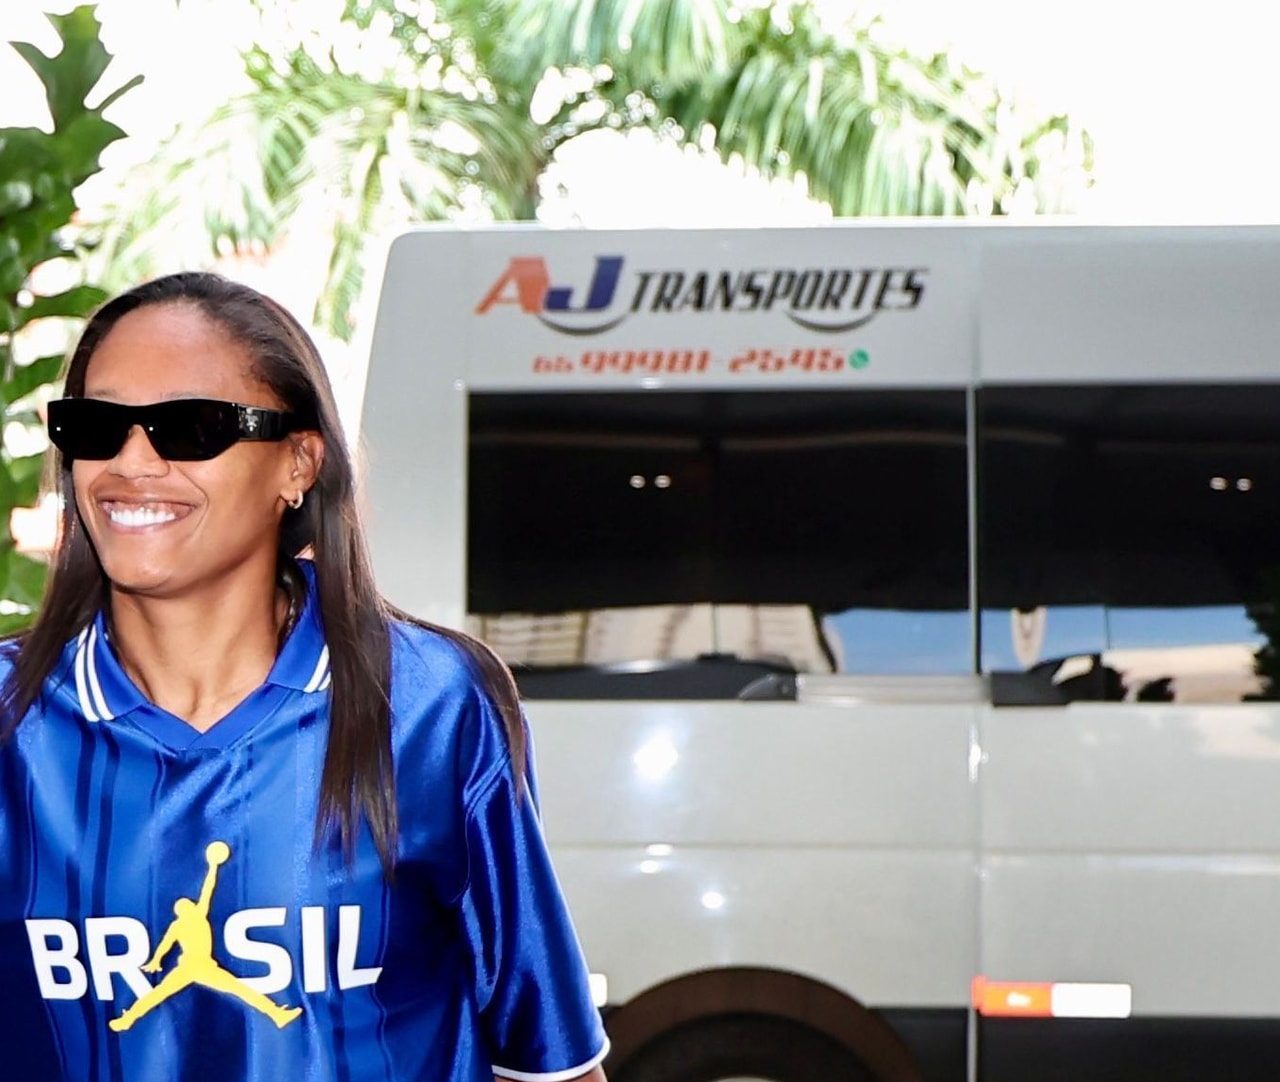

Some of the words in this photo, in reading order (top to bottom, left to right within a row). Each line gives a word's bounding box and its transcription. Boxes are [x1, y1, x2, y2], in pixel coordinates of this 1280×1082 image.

[473, 255, 625, 314] AJ
[628, 266, 930, 314] TRANSPORTES
[25, 902, 384, 1003] BRSIL
